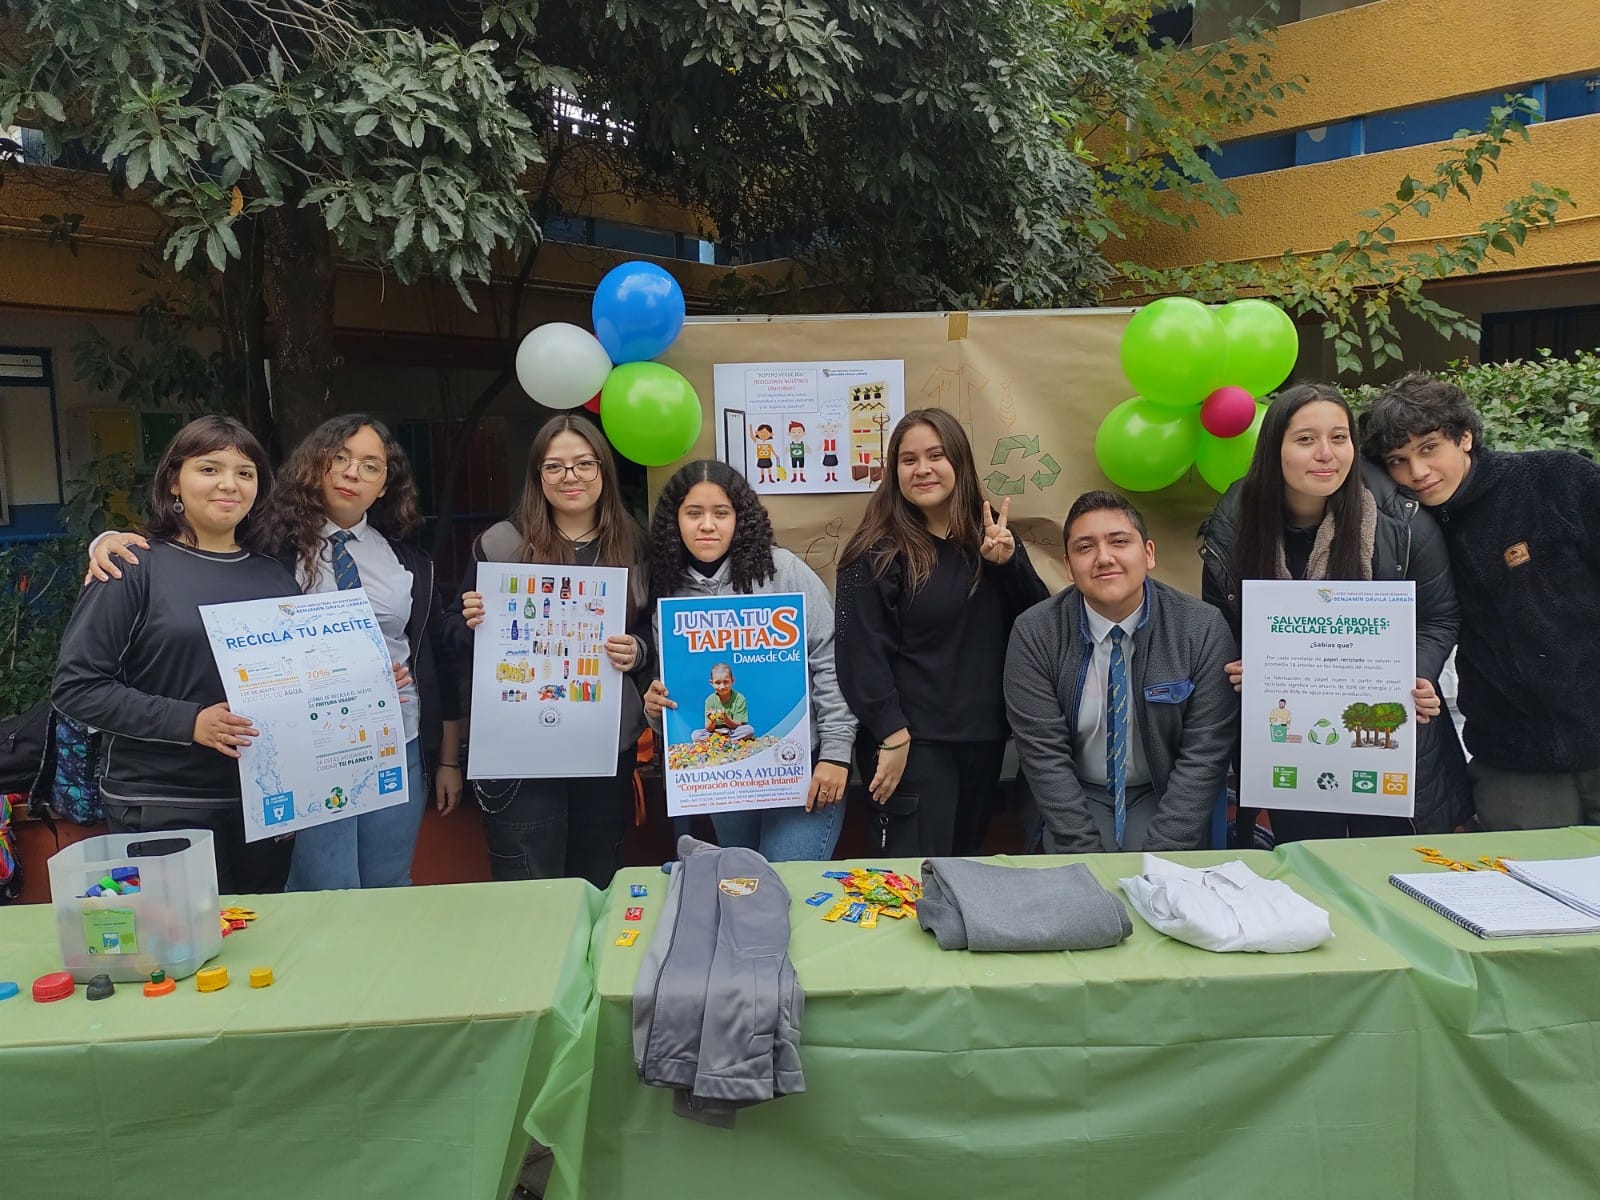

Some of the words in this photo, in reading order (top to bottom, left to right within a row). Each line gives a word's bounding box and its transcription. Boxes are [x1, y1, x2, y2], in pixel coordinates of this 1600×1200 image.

[676, 612, 738, 634] JUNTA
[743, 610, 770, 627] TU
[1266, 616, 1332, 626] “SALVEMOS
[1336, 614, 1390, 627] ÁRBOLES:
[226, 630, 294, 650] RECICLA
[296, 626, 318, 638] TU
[322, 618, 374, 636] ACEITE
[686, 609, 798, 650] TAPITAS
[1271, 624, 1326, 634] RECICLAJE
[1330, 626, 1344, 634] DE
[1346, 626, 1386, 635] PAPEL”
[306, 668, 330, 679] 70%
[348, 756, 373, 765] PLANETA
[676, 769, 742, 784] ¡AYUDANOS
[745, 769, 752, 778] A
[754, 766, 804, 777] AYUDAR!
